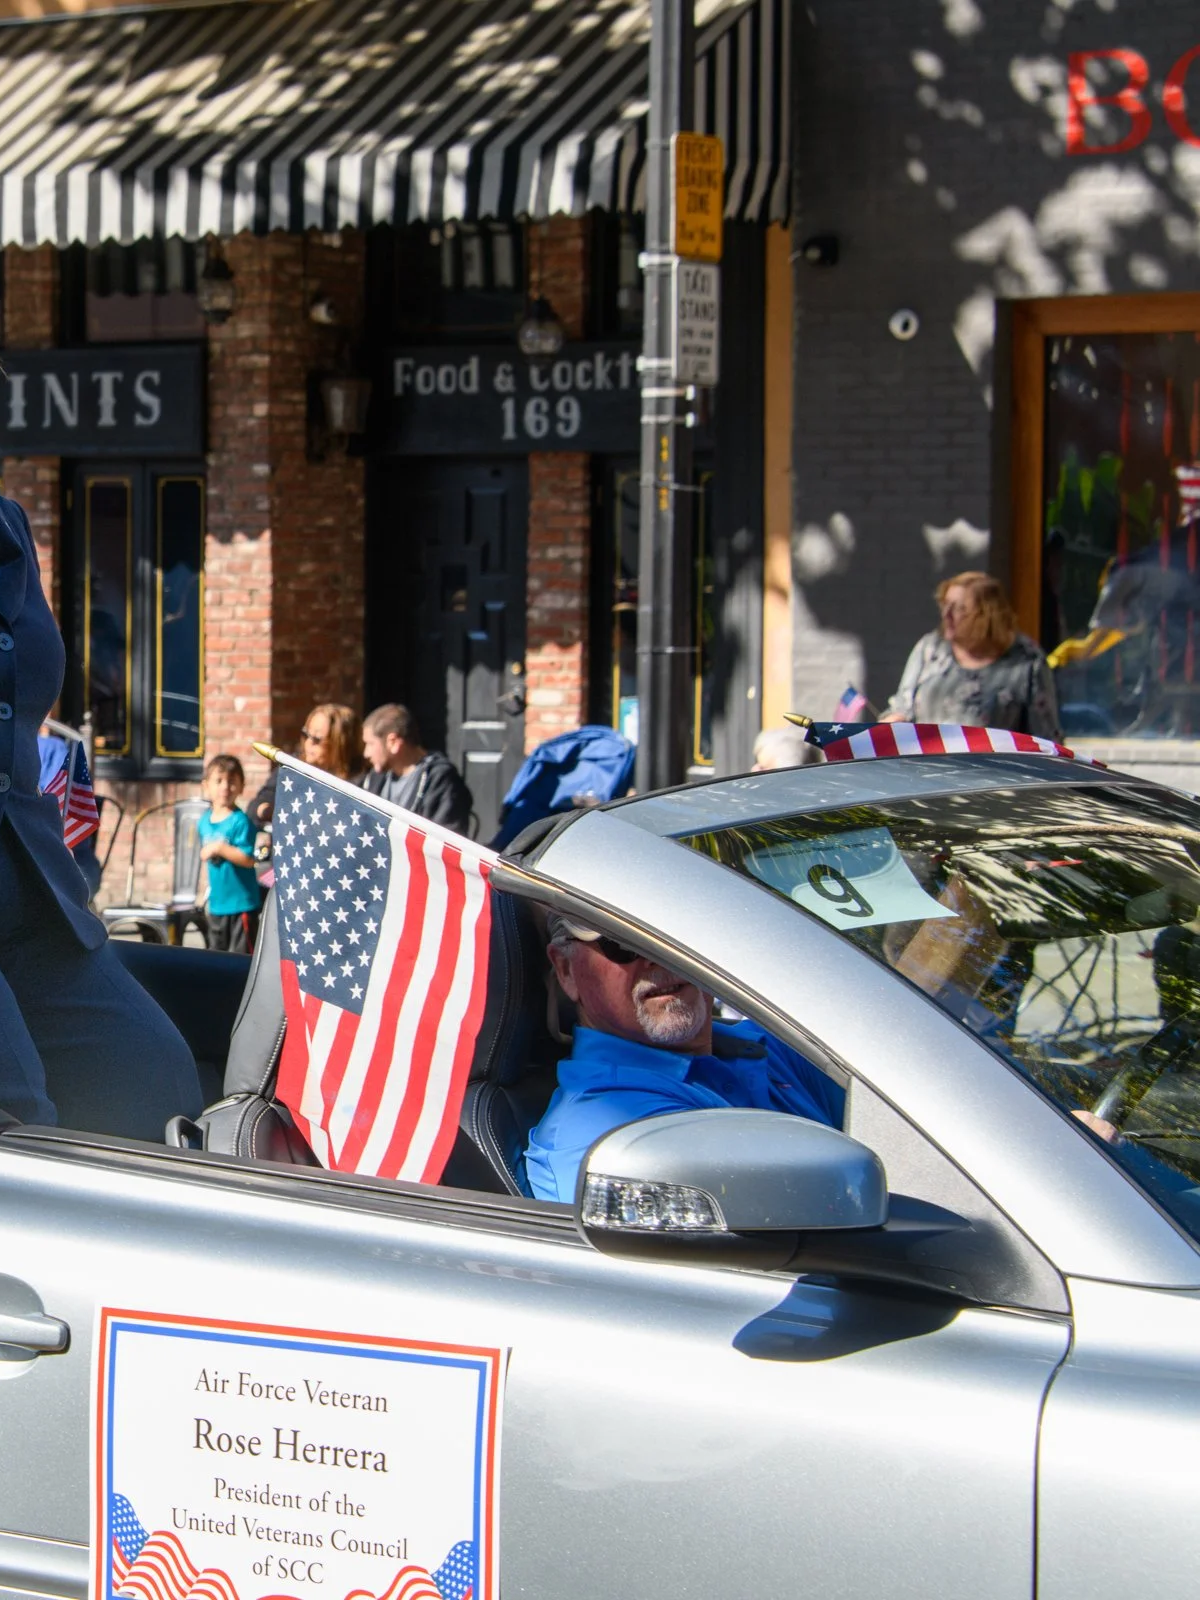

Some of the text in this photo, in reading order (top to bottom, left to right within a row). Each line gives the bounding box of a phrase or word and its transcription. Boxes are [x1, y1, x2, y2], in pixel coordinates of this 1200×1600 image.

[394, 351, 640, 396] Food & Cockt
[501, 395, 581, 440] 169
[807, 863, 874, 918] 9
[194, 1368, 389, 1413] Air Force Veteran
[193, 1417, 389, 1473] Rose Herrera
[213, 1477, 366, 1517] President of the
[171, 1507, 409, 1560] United Veterans Council
[252, 1555, 325, 1584] of SCC
